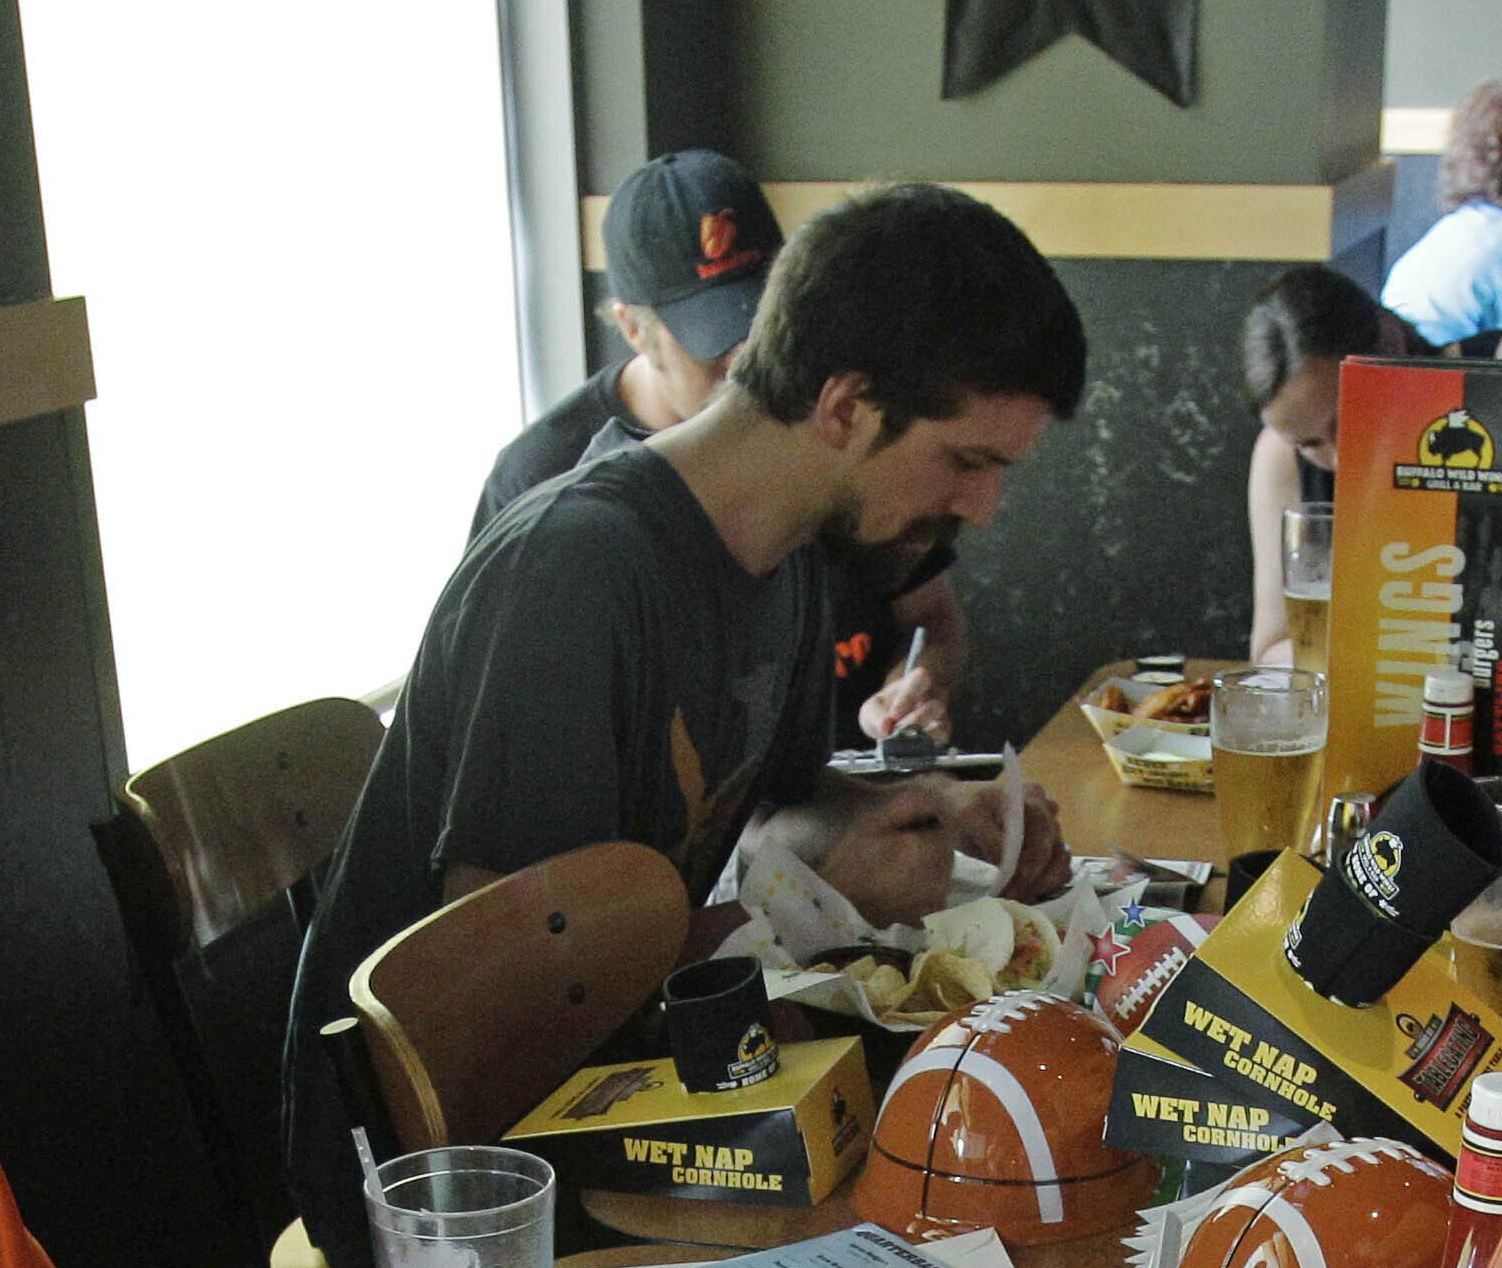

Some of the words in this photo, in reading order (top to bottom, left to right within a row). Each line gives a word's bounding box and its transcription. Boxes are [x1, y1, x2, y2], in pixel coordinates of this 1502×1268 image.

[1374, 541, 1466, 728] WINGS
[1183, 1000, 1252, 1051] WET
[1252, 1041, 1318, 1087] NAP
[1131, 1092, 1200, 1123] WET
[1207, 1102, 1270, 1132] NAP
[1223, 1049, 1337, 1121] CORNHOLE
[623, 1137, 688, 1166] WET
[695, 1144, 754, 1171] NAP
[672, 1166, 783, 1192] CORNHOLE
